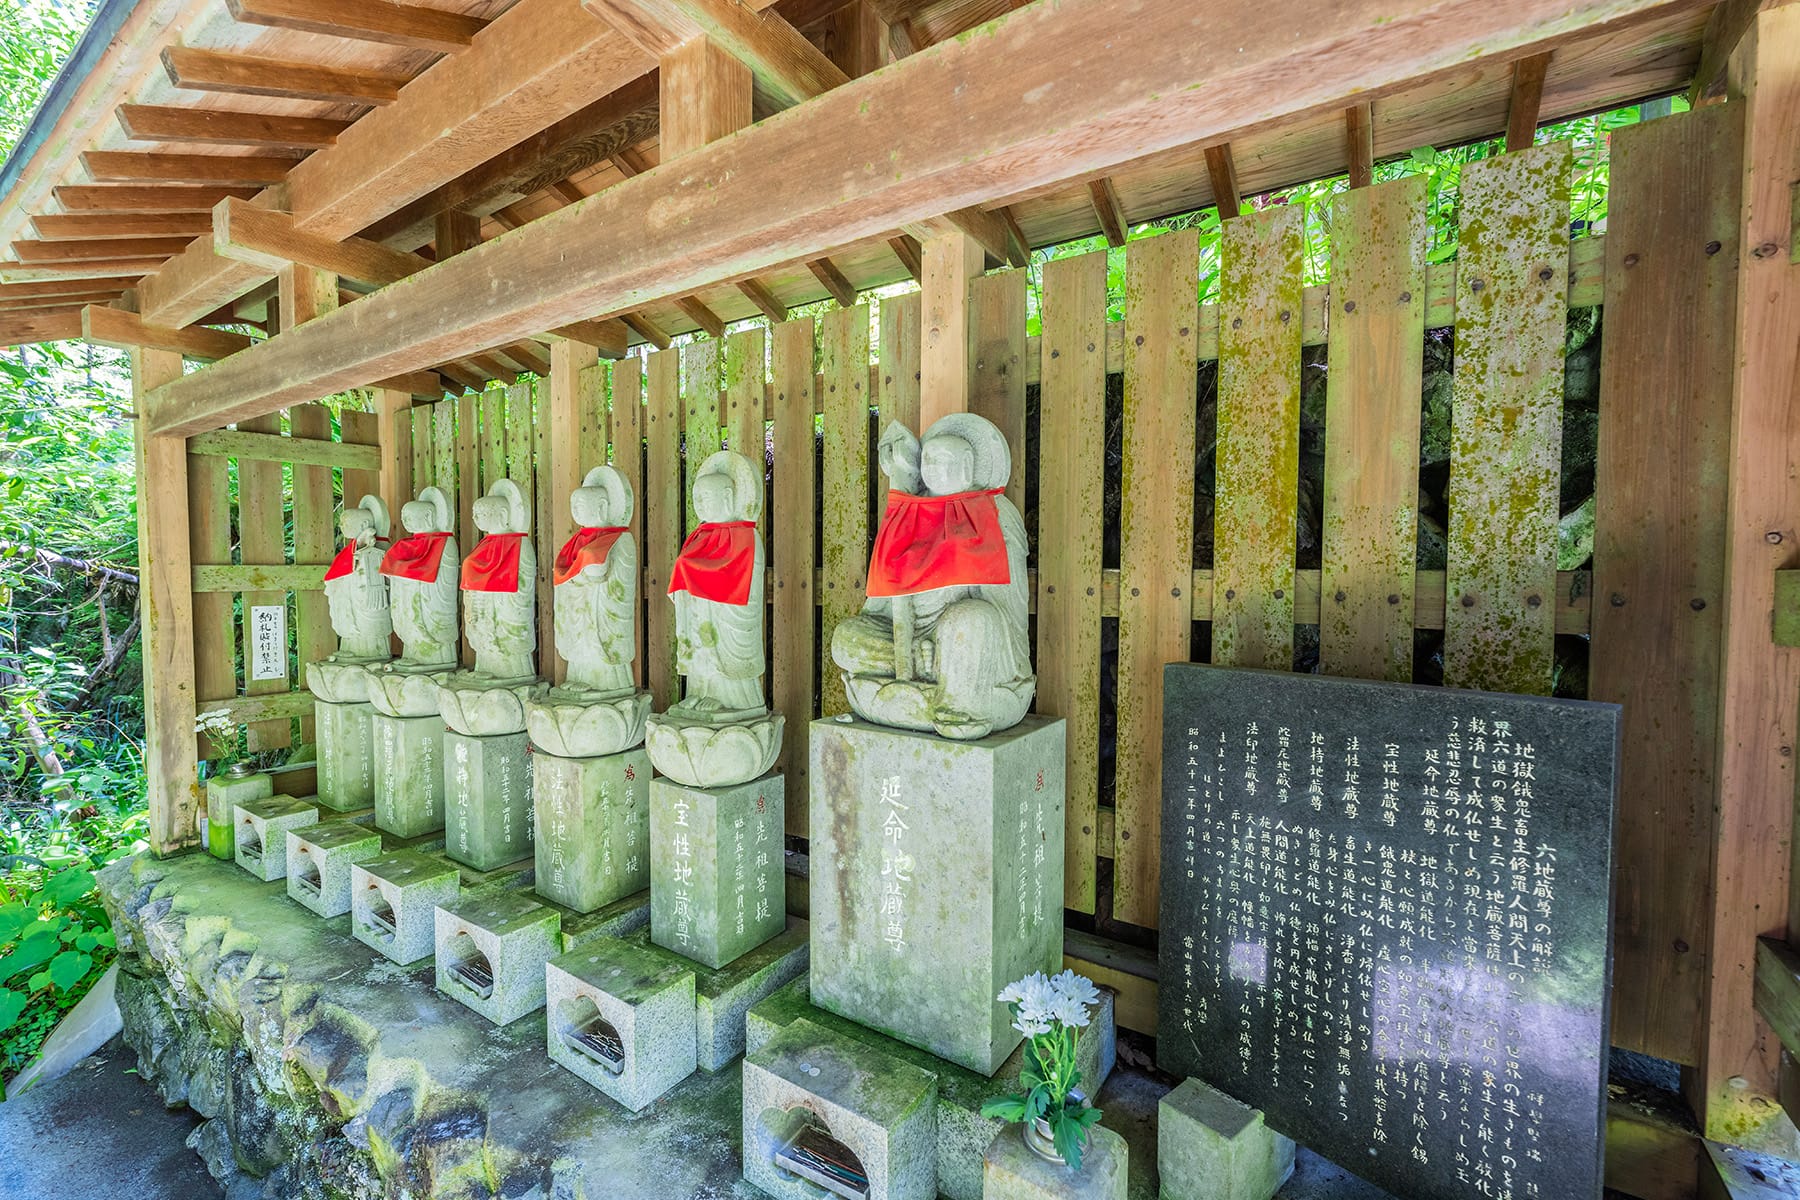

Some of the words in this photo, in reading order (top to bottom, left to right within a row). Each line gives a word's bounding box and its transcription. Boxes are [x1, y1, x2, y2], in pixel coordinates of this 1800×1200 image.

[455, 742, 469, 854] 持地蔵尊
[1244, 721, 1259, 796] 法印地蔵尊
[1276, 726, 1291, 803] 陀羅尼地蔵尊
[1308, 731, 1325, 812] 地持地蔵尊
[1342, 737, 1360, 819] 法性地蔵尊
[1382, 743, 1400, 827] 宝性地蔵尊
[1421, 749, 1441, 836] 延命地蔵尊
[672, 798, 694, 946] 宝性地蔵尊
[879, 774, 911, 952] 延命地蔵尊
[1242, 812, 1257, 885] 天上道能化
[1273, 819, 1289, 896] 人間道能化
[1305, 827, 1323, 906] 修羅道能化
[1339, 835, 1358, 918] 畜生道能化
[1377, 844, 1397, 929] 餓鬼道能化
[1419, 854, 1440, 941] 地獄道能化
[1531, 843, 1557, 977] 六地蔵尊の解説
[1337, 933, 1355, 1121] 浄香により清浄無垢なつ
